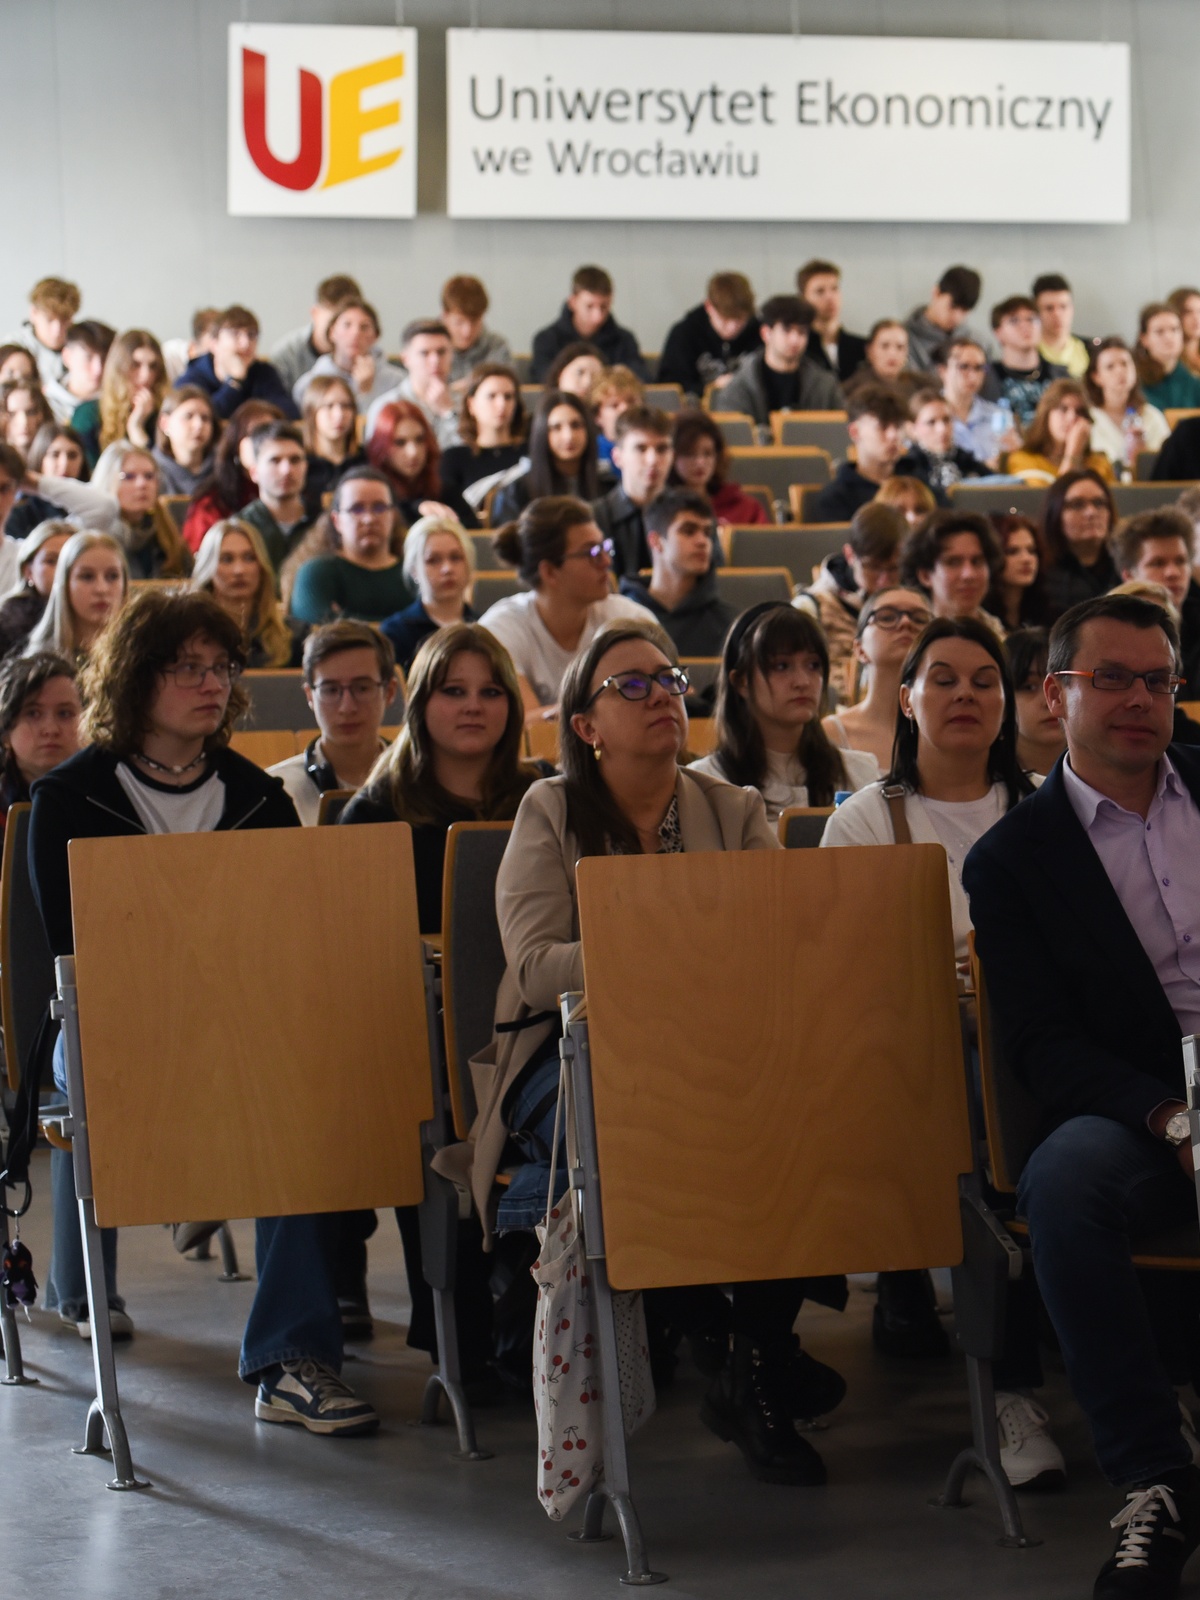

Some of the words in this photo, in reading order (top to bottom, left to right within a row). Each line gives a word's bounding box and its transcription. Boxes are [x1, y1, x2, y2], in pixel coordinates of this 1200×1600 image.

[470, 76, 774, 135] Uniwersytet
[796, 79, 1112, 141] Ekonomiczny
[473, 149, 531, 176] we
[548, 140, 759, 179] Wrocławiu
